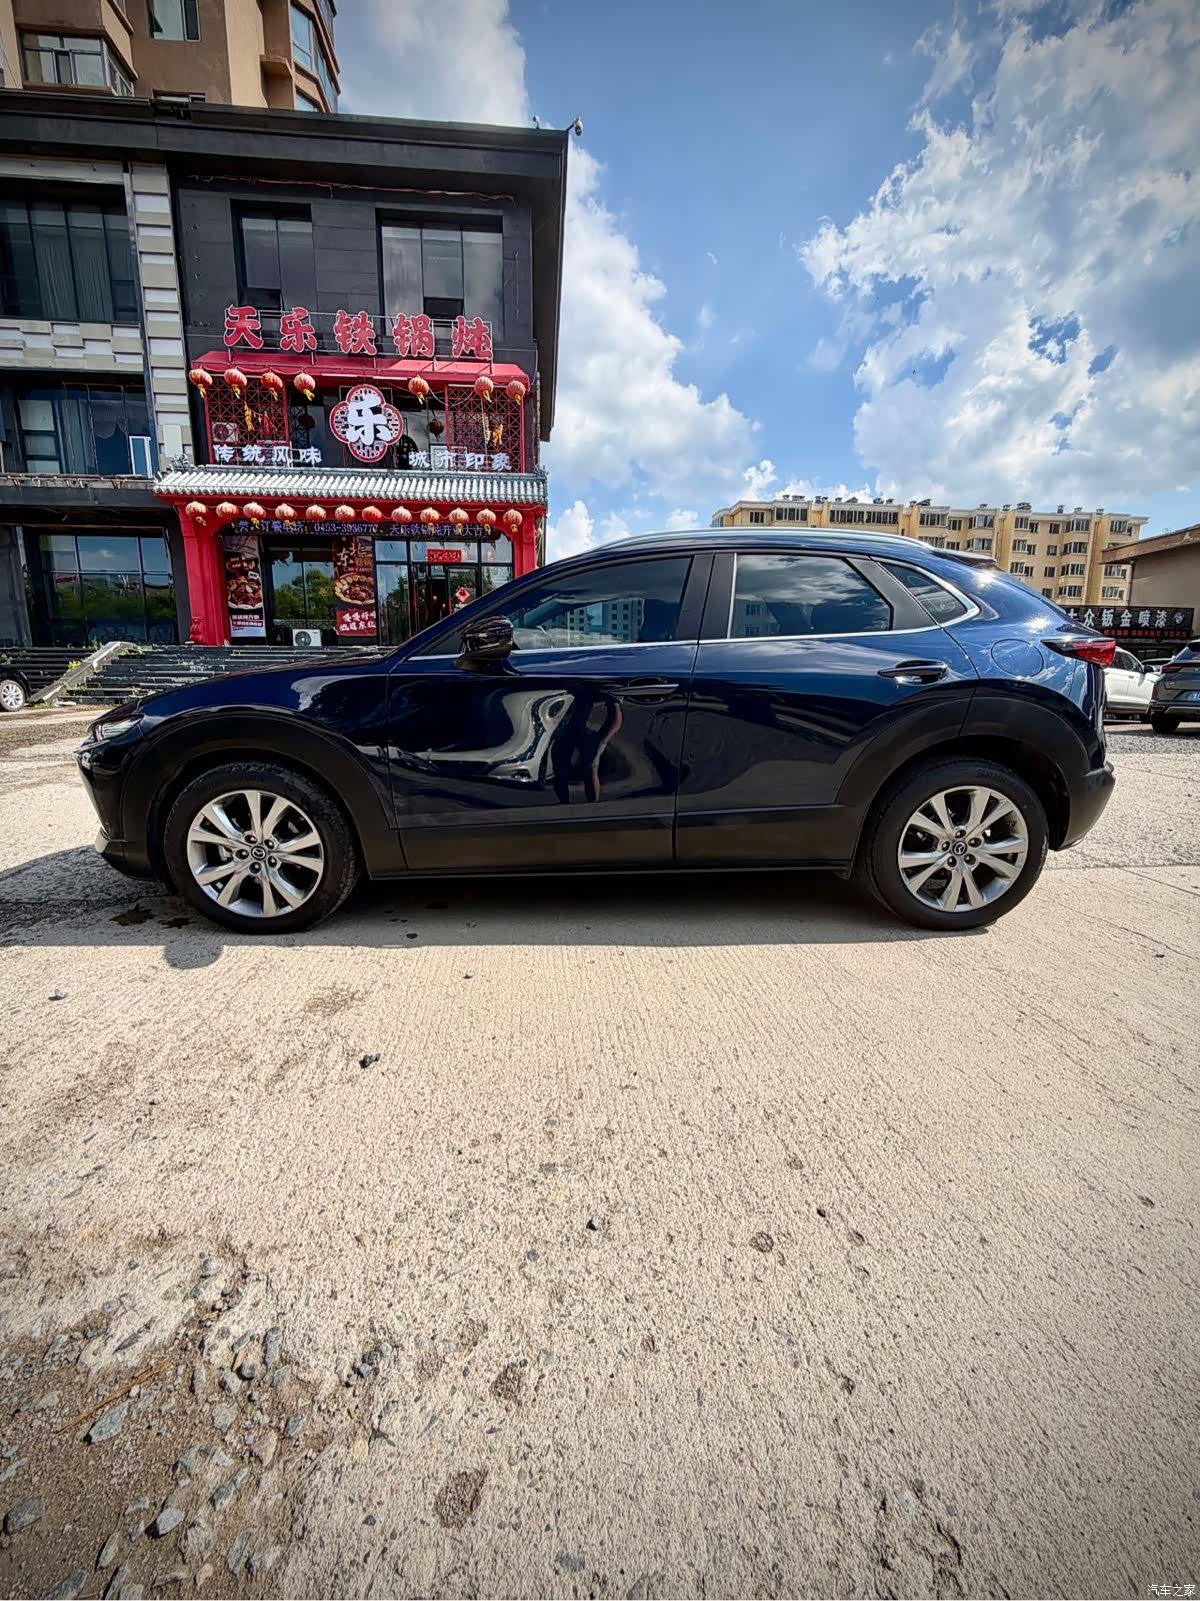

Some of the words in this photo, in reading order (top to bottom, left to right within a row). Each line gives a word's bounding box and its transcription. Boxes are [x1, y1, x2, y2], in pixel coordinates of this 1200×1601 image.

[223, 304, 494, 360] 天乐铁锅炖
[346, 391, 393, 446] 乐
[212, 444, 322, 466] 传统风味
[408, 450, 513, 471] 城市印象
[389, 523, 484, 536] 天乐铁锅炖开大吉
